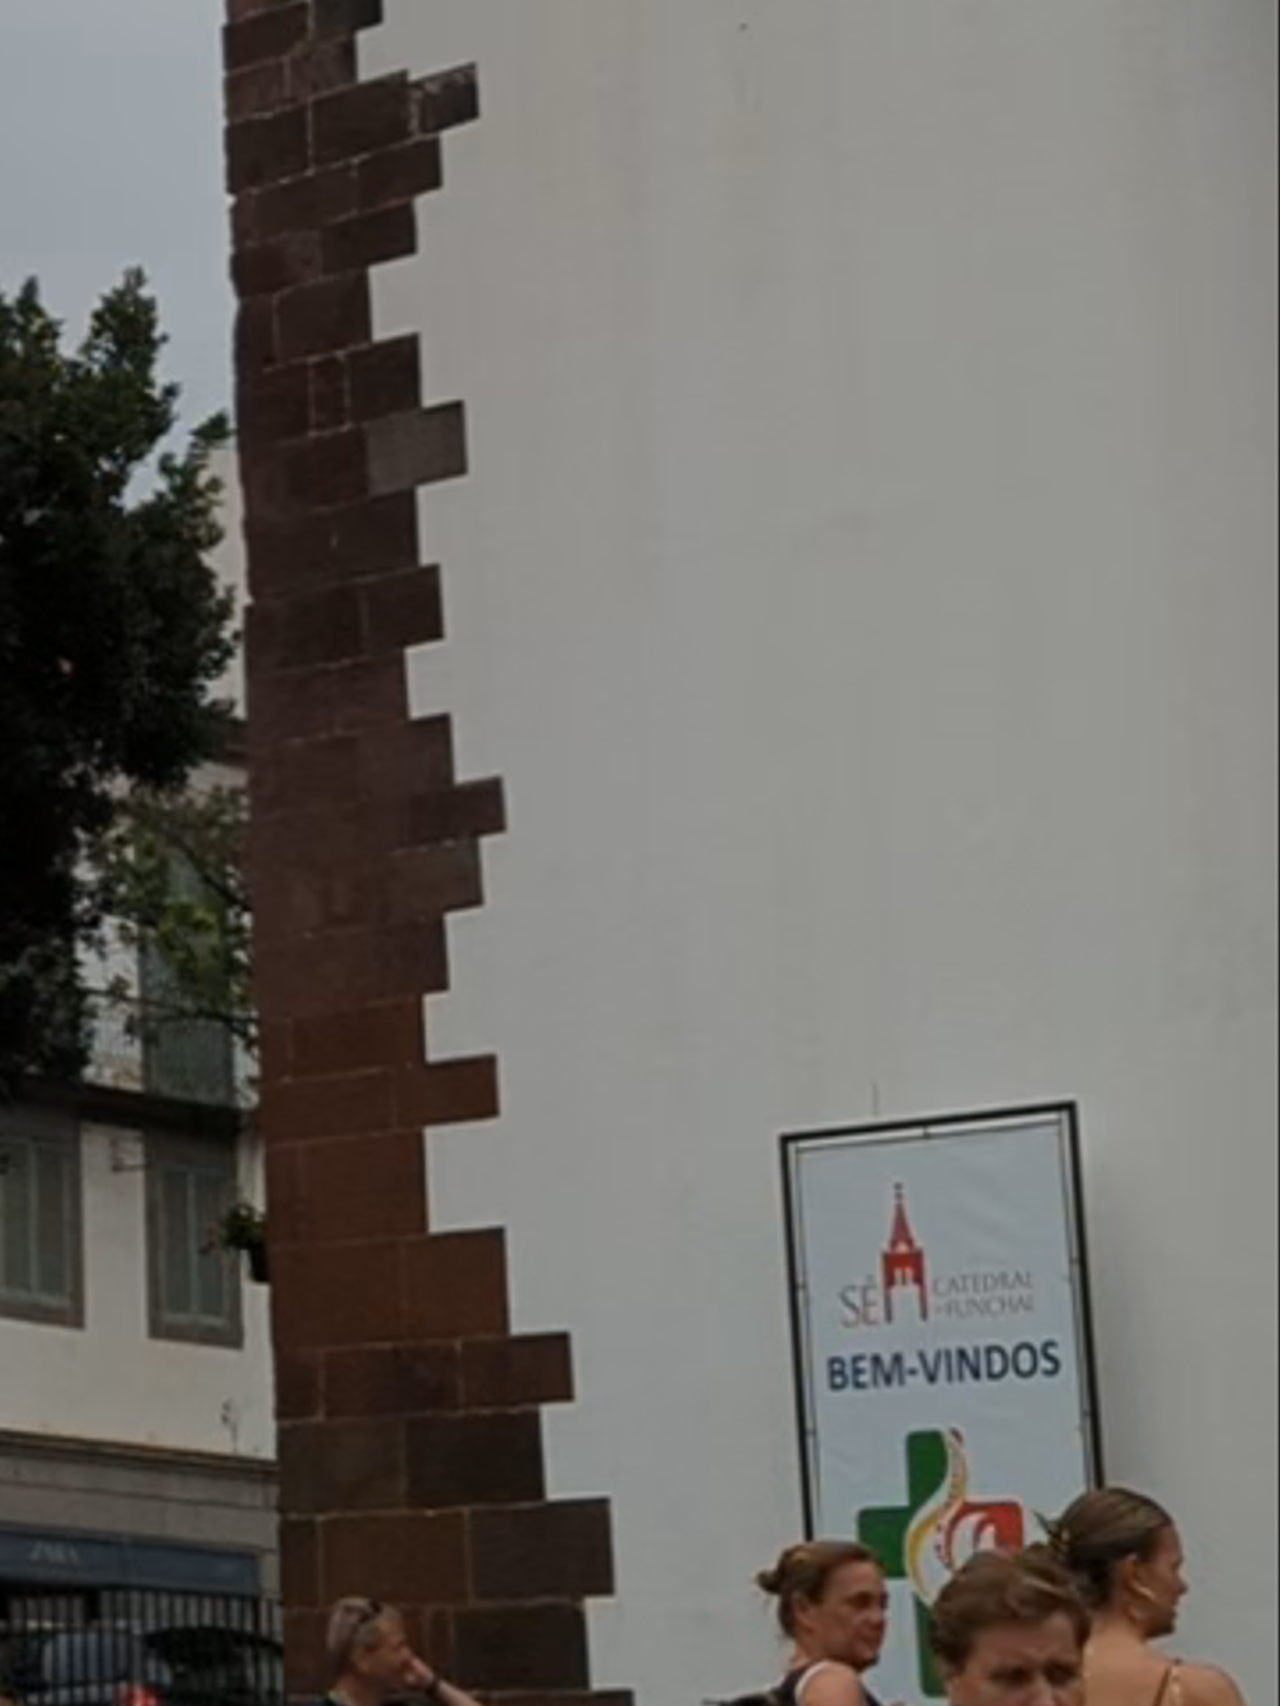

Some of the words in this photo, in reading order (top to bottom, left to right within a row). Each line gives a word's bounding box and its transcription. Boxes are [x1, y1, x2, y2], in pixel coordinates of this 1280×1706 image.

[932, 1271, 1034, 1297] CATEDRAL
[943, 1294, 1035, 1319] FUNCHAL
[827, 1339, 1061, 1391] BEM-VINDOS
